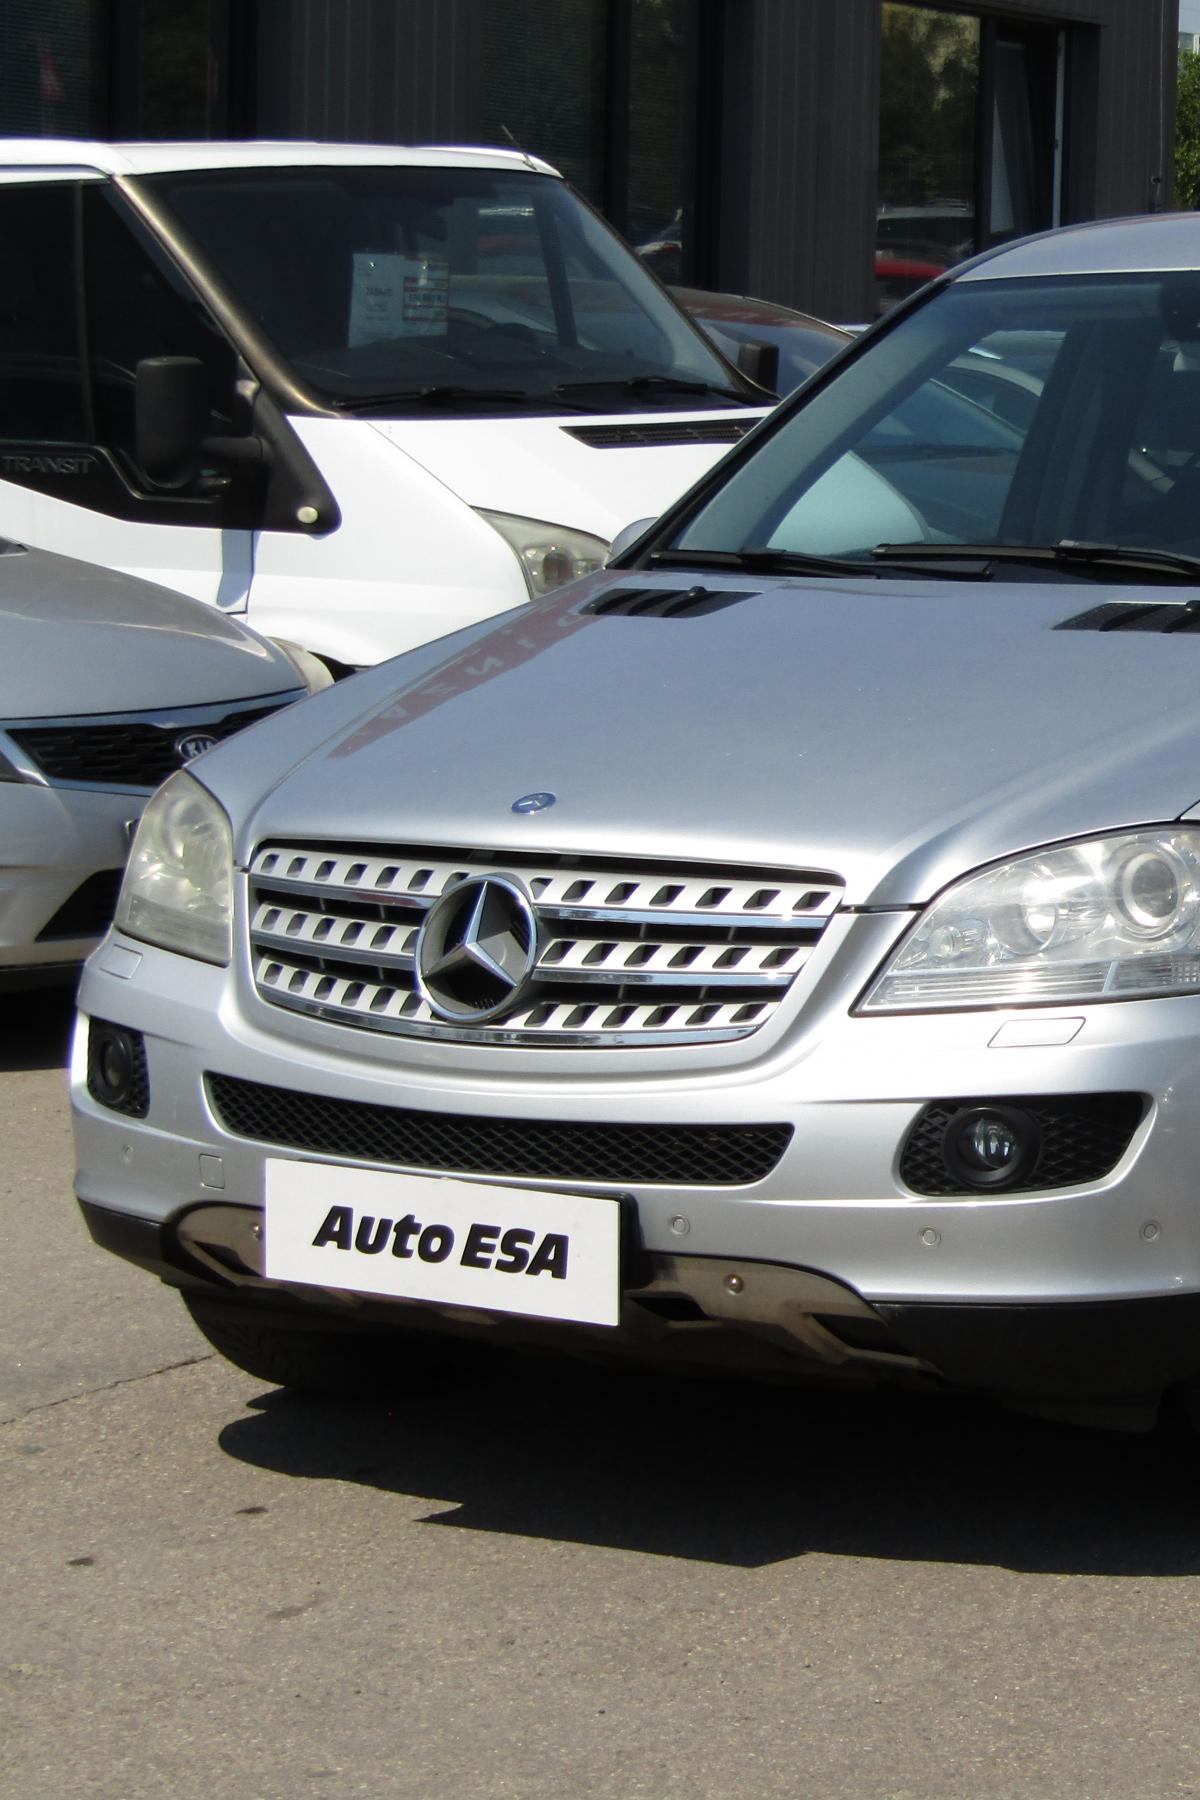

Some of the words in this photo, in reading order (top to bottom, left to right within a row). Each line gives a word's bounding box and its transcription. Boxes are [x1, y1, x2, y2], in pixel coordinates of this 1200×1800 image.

[1, 455, 90, 474] TRANSIT
[312, 1205, 455, 1263] Auto
[460, 1223, 569, 1279] ESA
